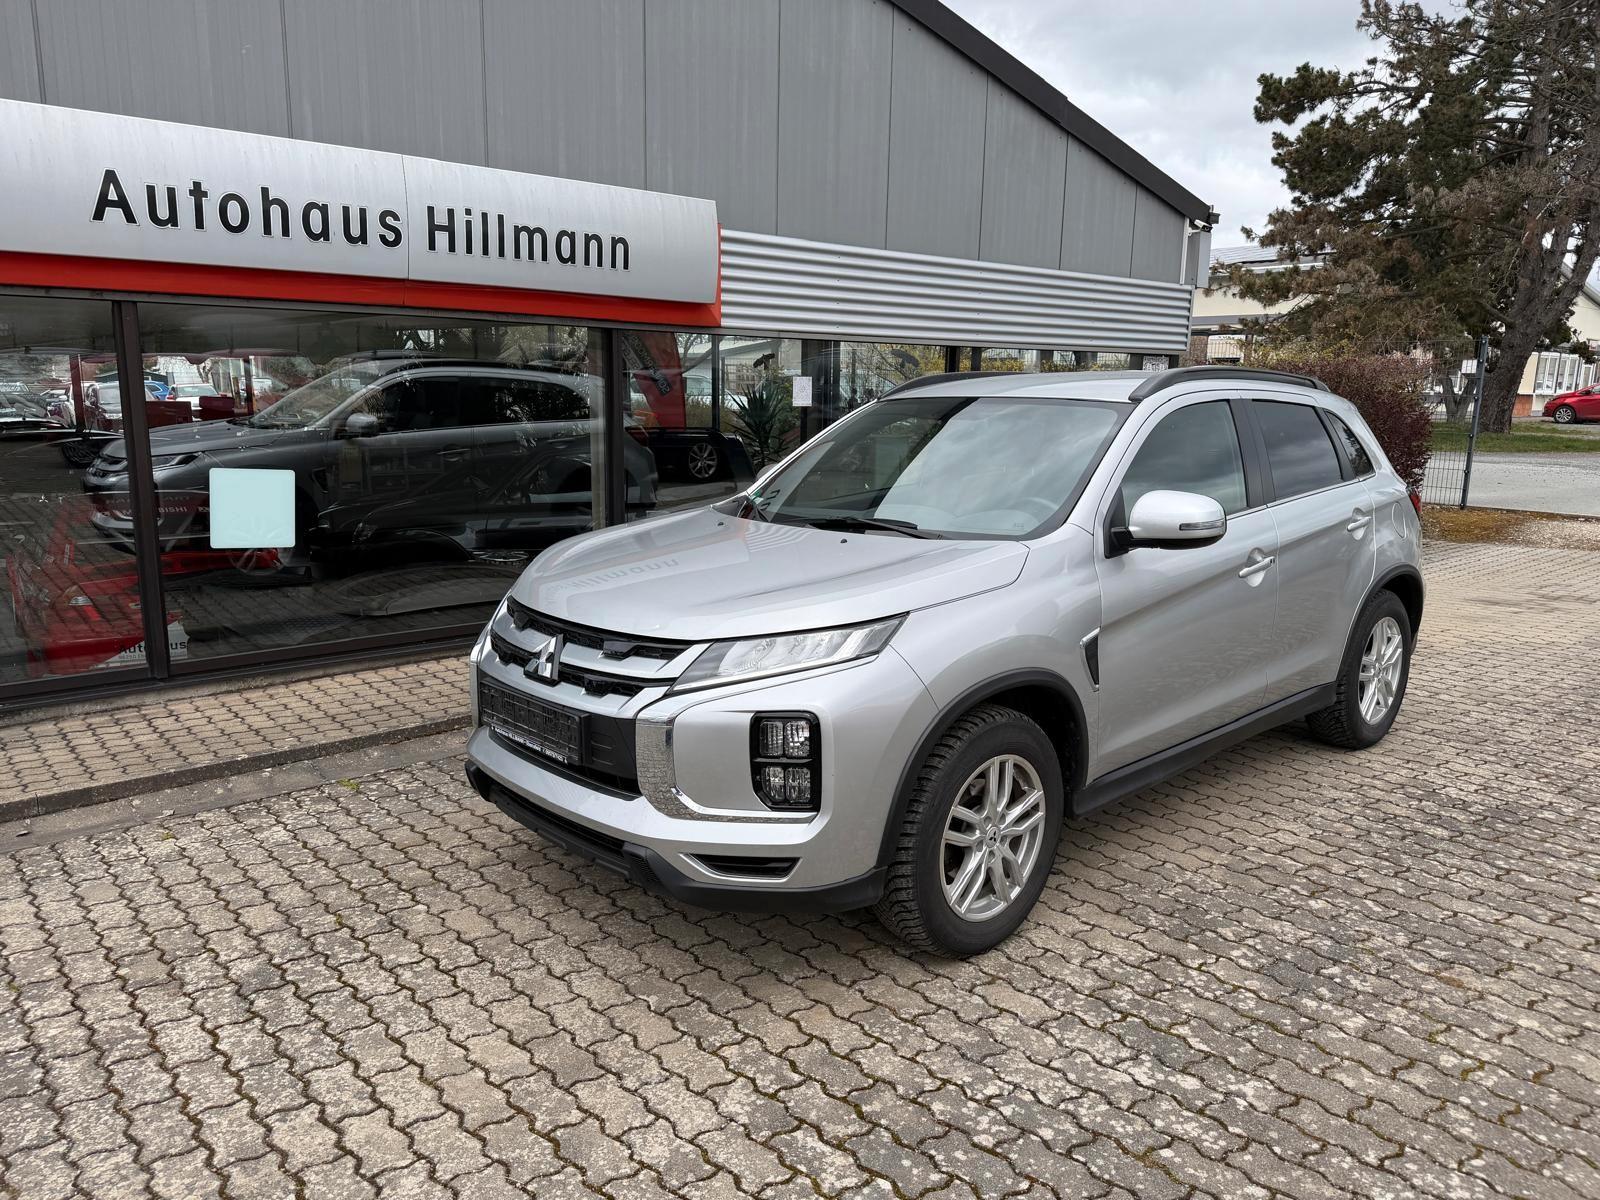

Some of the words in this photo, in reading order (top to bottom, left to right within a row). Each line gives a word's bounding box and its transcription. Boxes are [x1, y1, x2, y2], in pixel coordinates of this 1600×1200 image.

[91, 167, 404, 248] Autohaus
[426, 205, 630, 270] Hillmann
[119, 641, 187, 654] Autus
